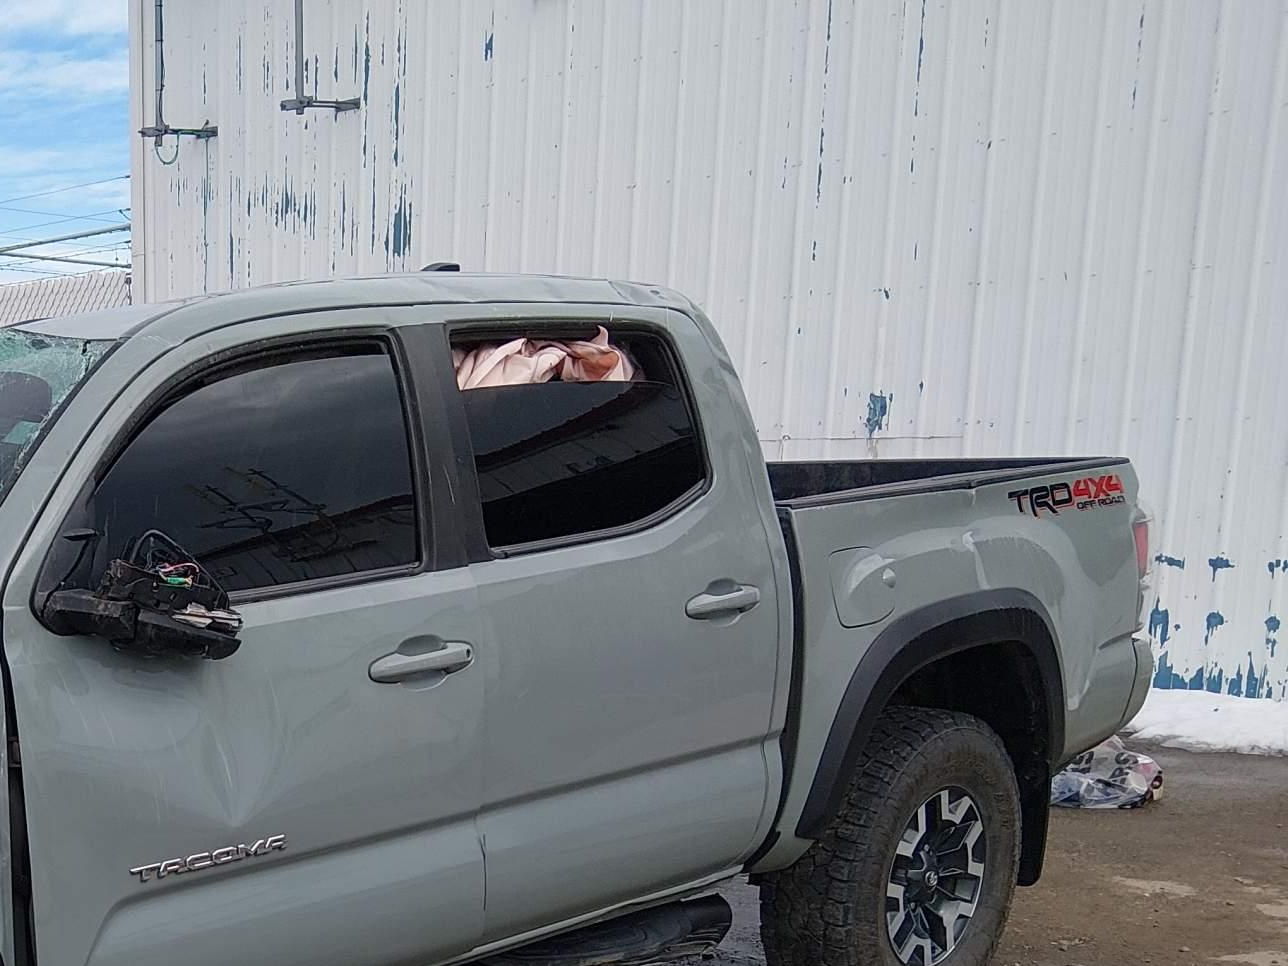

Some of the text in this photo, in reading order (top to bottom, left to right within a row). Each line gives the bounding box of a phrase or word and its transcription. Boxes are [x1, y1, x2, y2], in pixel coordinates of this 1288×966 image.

[1007, 482, 1073, 518] TRD
[1076, 495, 1126, 510] OFF ROAD
[129, 834, 287, 883] TACOMA
